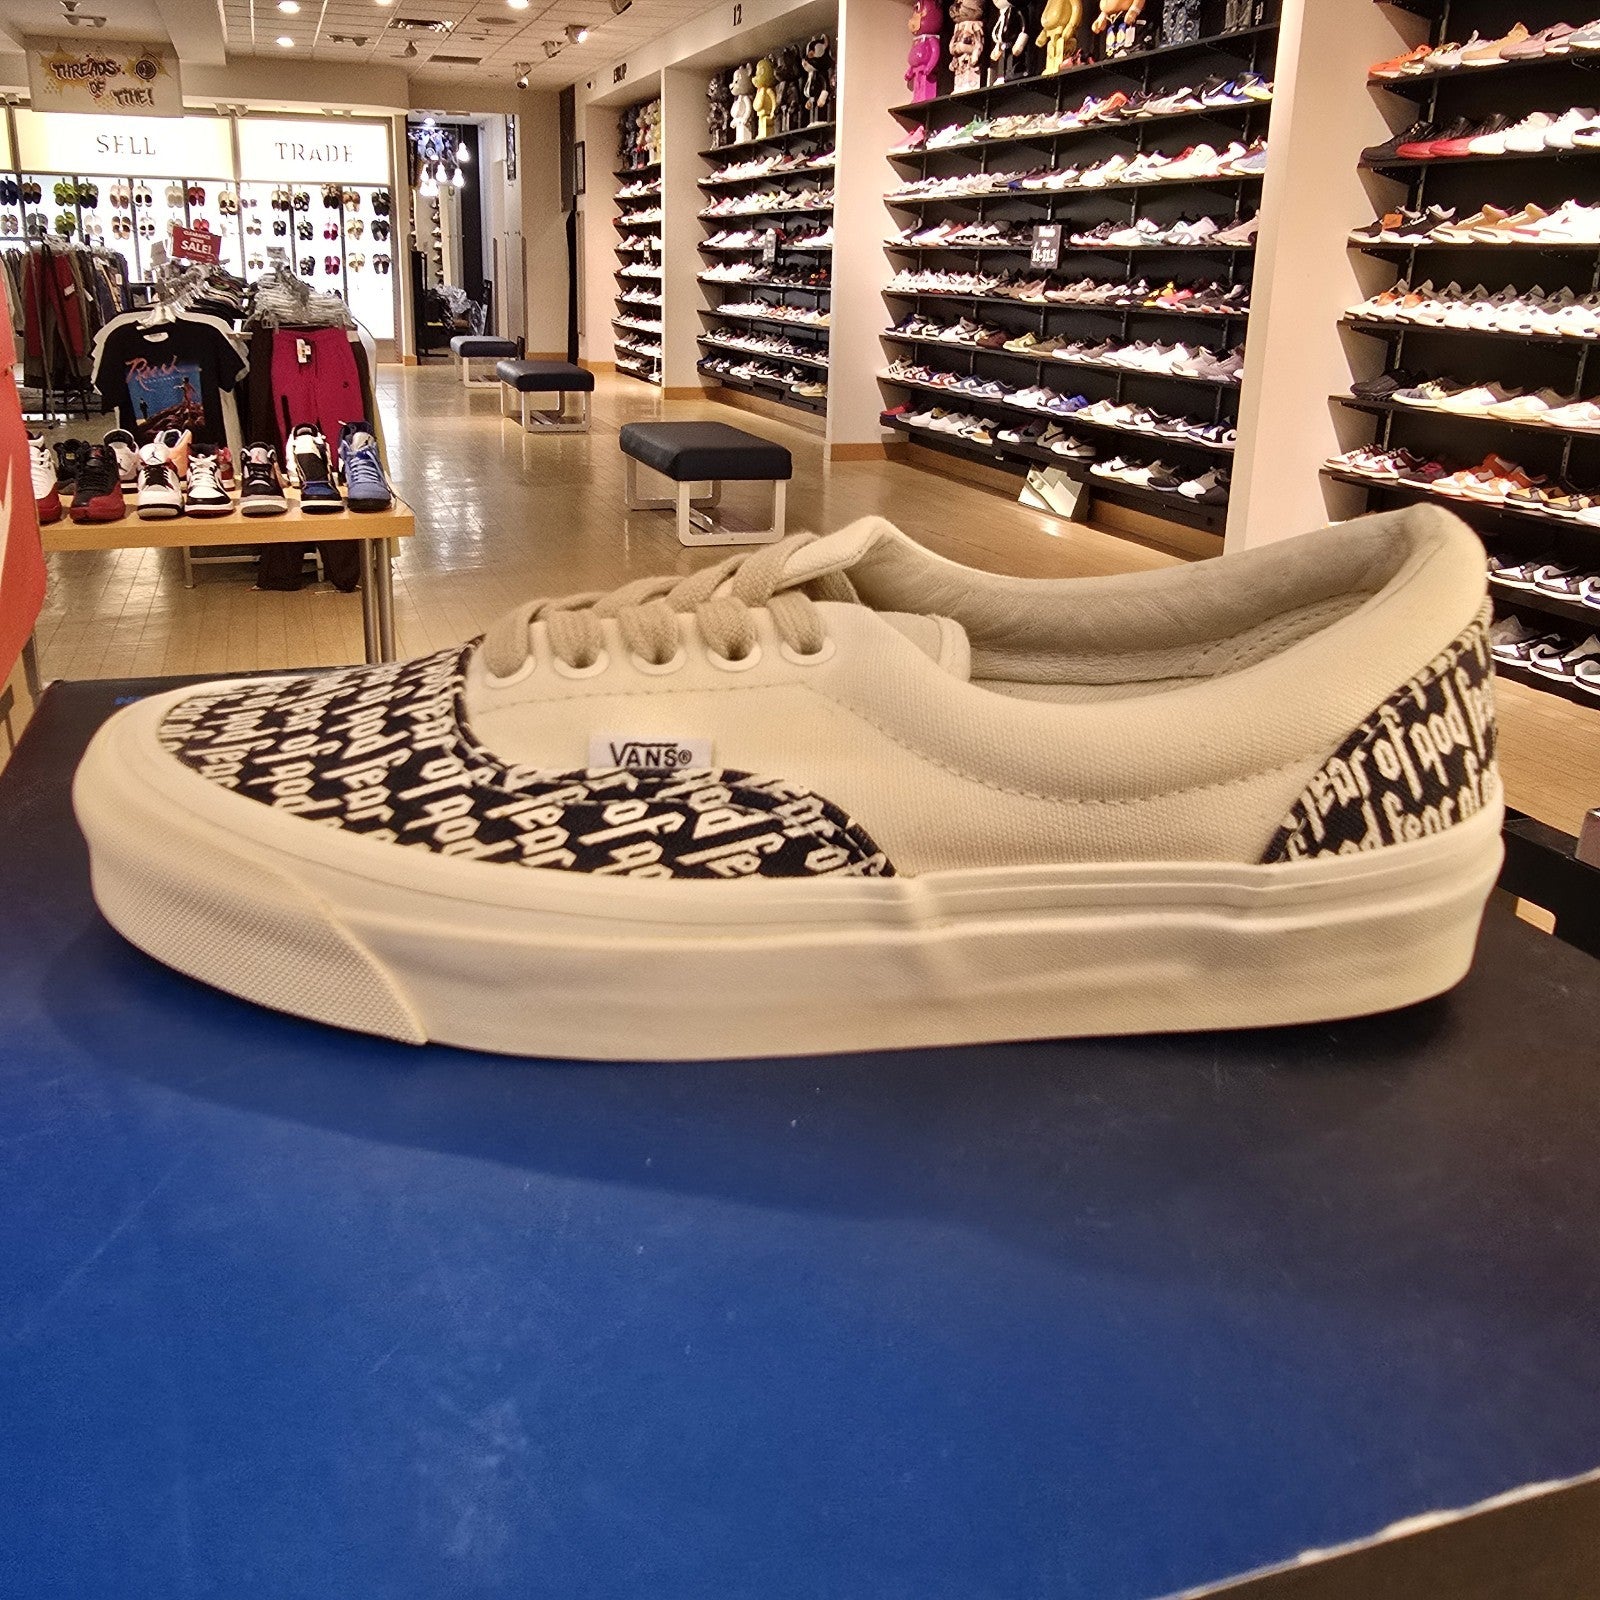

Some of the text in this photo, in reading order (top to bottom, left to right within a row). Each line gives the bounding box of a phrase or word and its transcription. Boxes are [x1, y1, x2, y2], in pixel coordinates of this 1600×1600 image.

[733, 3, 743, 26] 12
[50, 58, 118, 80] THREADS
[87, 80, 106, 98] OF
[96, 134, 156, 155] SELL
[274, 142, 353, 163] TRADE
[180, 240, 212, 255] SALE!
